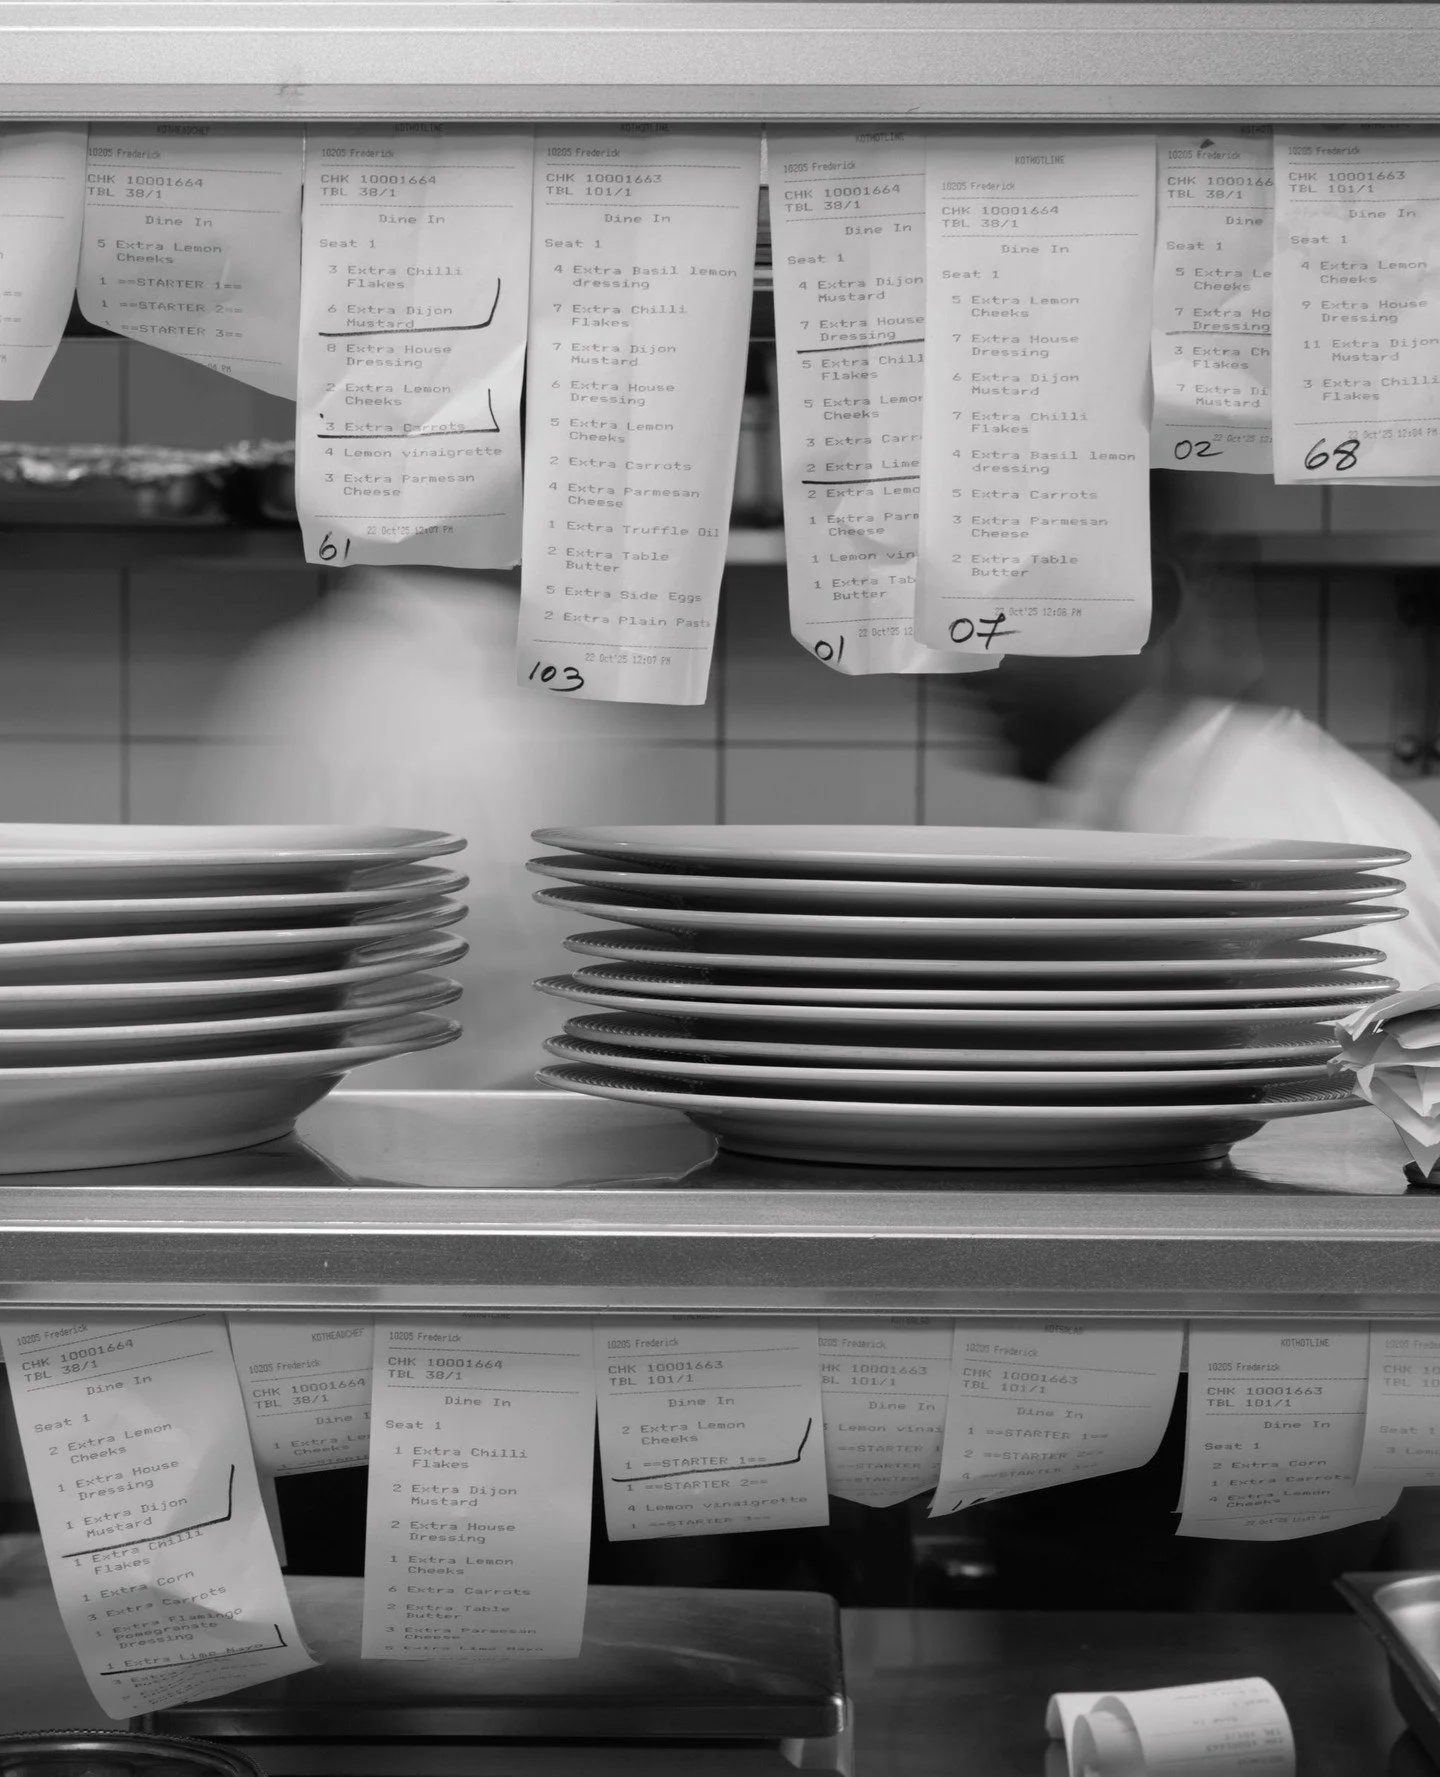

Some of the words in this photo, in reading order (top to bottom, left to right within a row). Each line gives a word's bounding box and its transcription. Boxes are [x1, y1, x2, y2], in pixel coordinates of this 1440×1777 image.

[87, 173, 115, 185] CHK
[127, 176, 203, 187] 10001664
[321, 174, 349, 183] CHK
[361, 175, 435, 184] 10001664
[546, 173, 575, 183] CHK
[586, 174, 662, 184] 10001663
[1288, 172, 1317, 181] CHK
[1329, 171, 1405, 181] 10001663
[87, 186, 114, 198] TBL
[125, 188, 161, 199] 38/1
[320, 187, 347, 196] TBL
[359, 188, 396, 197] 38/1
[545, 186, 573, 195] TBL
[586, 187, 631, 196] 101/1
[785, 189, 813, 200] CHK
[825, 184, 900, 197] 10001664
[1289, 184, 1317, 193] TBL
[1328, 185, 1375, 193] 101/1
[1168, 190, 1195, 198] TBL
[1206, 190, 1242, 199] 38/1
[784, 203, 813, 212] TBL
[824, 200, 863, 210] 38/1
[942, 207, 970, 215] CHK
[982, 206, 1058, 216] 10001664
[146, 215, 183, 225] Dine
[195, 217, 212, 227] In
[379, 214, 417, 224] Dine
[428, 215, 445, 224] In
[942, 219, 969, 227] TBL
[981, 219, 1018, 228] 38/1
[845, 226, 882, 235] Dine
[894, 224, 912, 232] In
[320, 239, 357, 247] Seat
[370, 240, 375, 248] 1
[1291, 235, 1329, 244] Seat
[1341, 235, 1347, 243] 1
[97, 239, 105, 248] 5
[116, 240, 163, 251] Extra
[174, 242, 221, 253] Lemon
[1001, 245, 1039, 253] Dine
[1051, 245, 1069, 253] In
[1167, 241, 1204, 250] Seat
[1217, 242, 1222, 250] 1
[116, 253, 173, 263] Cheeks
[329, 265, 337, 273] 3
[348, 266, 396, 275] Extra
[407, 267, 462, 276] Chilli
[554, 265, 563, 273] 4
[573, 265, 621, 275] Extra
[633, 266, 678, 275] Basil
[690, 266, 736, 276] lemon
[99, 277, 106, 285] 1
[347, 279, 404, 288] Flakes
[573, 278, 649, 290] dressing
[799, 281, 807, 290] 4
[818, 280, 865, 289] Extra
[876, 276, 923, 287] Dijon
[1194, 281, 1250, 291] Cheeks
[818, 291, 885, 302] Mustard
[952, 296, 961, 304] 5
[972, 296, 1019, 304] Extra
[1030, 296, 1079, 304] Lemon
[971, 308, 1029, 317] Cheeks
[327, 343, 336, 352] 8
[345, 344, 394, 353] Extra
[405, 345, 451, 353] House
[1304, 340, 1320, 349] 11
[1332, 339, 1379, 348] Extra
[1390, 338, 1439, 348] Dijon
[1332, 352, 1399, 361] Mustard
[346, 357, 422, 369] Dressing
[1174, 440, 1224, 460] 02
[1304, 438, 1361, 471] 68
[953, 515, 961, 524] 3
[972, 516, 1019, 525] Extra
[1030, 517, 1108, 525] Parmesan
[550, 520, 555, 528] 1
[567, 521, 613, 532] Extra
[623, 525, 688, 535] Truffle
[698, 528, 719, 537] Oil
[971, 529, 1029, 538] Cheese
[319, 530, 351, 561] 61
[548, 547, 556, 555] 2
[566, 548, 612, 559] Extra
[623, 552, 669, 561] Table
[566, 560, 620, 572] Butter
[546, 585, 556, 594] 5
[565, 587, 611, 598] Extra
[620, 591, 658, 600] Side
[669, 592, 701, 603] Eggs
[949, 613, 1021, 650] 07
[814, 635, 844, 664] 01
[585, 653, 595, 662] 22
[661, 656, 670, 665] PM
[529, 661, 585, 692] 103
[17, 1333, 41, 1346] 10205
[44, 1324, 88, 1339] Frederick
[21, 1357, 50, 1371] CHK
[60, 1338, 134, 1363] 10001664
[388, 1356, 416, 1367] CHK
[428, 1358, 503, 1369] 10001664
[608, 1365, 636, 1374] CHK
[648, 1361, 723, 1372] 10001663
[24, 1370, 52, 1382] TBL
[61, 1360, 98, 1374] 38/1
[388, 1369, 414, 1379] TBL
[426, 1370, 461, 1380] 38/1
[963, 1368, 991, 1378] CHK
[1002, 1371, 1078, 1384] 10001663
[609, 1377, 637, 1386] TBL
[648, 1374, 693, 1384] 101/1
[253, 1388, 281, 1398] CHK
[291, 1377, 366, 1394] 10001664
[963, 1380, 989, 1389] TBL
[1002, 1383, 1045, 1393] 101/1
[1206, 1387, 1238, 1396] CHK
[1247, 1387, 1323, 1396] 10001663
[255, 1400, 282, 1409] TBL
[292, 1394, 329, 1405] 38/1
[1207, 1399, 1234, 1407] TBL
[1246, 1398, 1291, 1408] 101/1
[1017, 1407, 1054, 1417] Dine
[1065, 1410, 1083, 1419] In
[386, 1420, 423, 1429] Seat
[435, 1421, 441, 1430] 1
[622, 1426, 630, 1434] 2
[640, 1424, 688, 1433] Extra
[698, 1421, 745, 1429] Lemon
[49, 1447, 60, 1455] 2
[68, 1436, 115, 1451] Extra
[124, 1424, 172, 1439] Lemon
[641, 1435, 698, 1445] Cheeks
[395, 1446, 402, 1454] 1
[413, 1447, 461, 1456] Extra
[471, 1448, 528, 1458] Chilli
[1204, 1442, 1243, 1451] Seat
[70, 1447, 127, 1464] Cheeks
[412, 1459, 469, 1468] Flakes
[625, 1461, 632, 1469] 1
